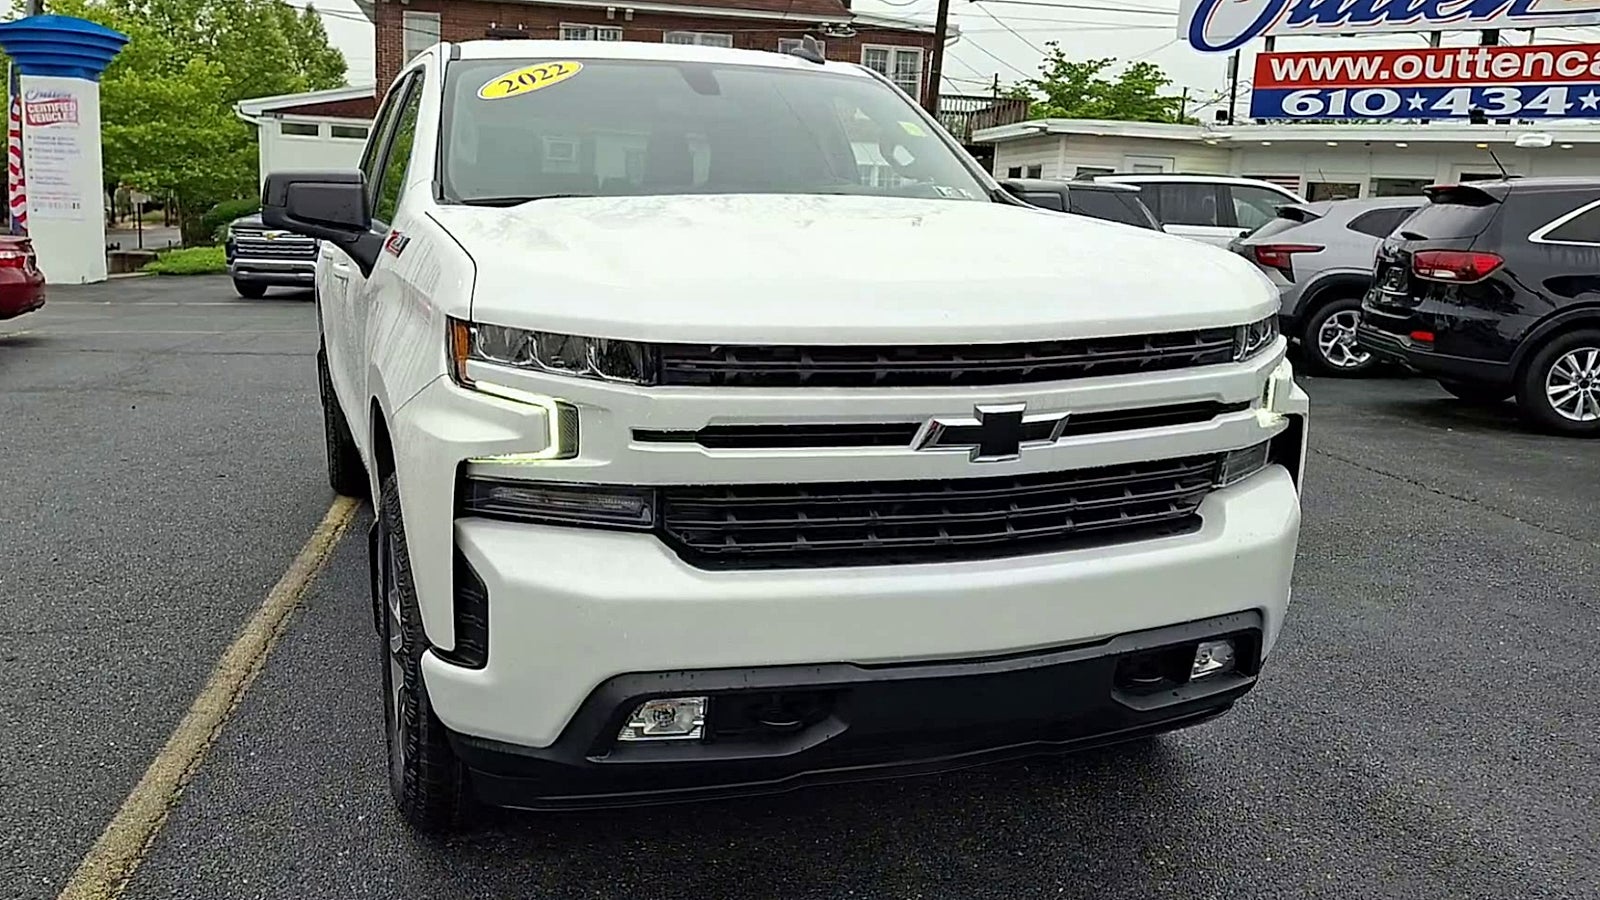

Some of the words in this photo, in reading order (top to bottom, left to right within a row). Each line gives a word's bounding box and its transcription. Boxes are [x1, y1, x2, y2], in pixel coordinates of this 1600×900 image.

[498, 63, 569, 93] 2022
[27, 101, 77, 114] CERTIFIED
[1282, 88, 1400, 116] 610
[1431, 86, 1574, 115] 434
